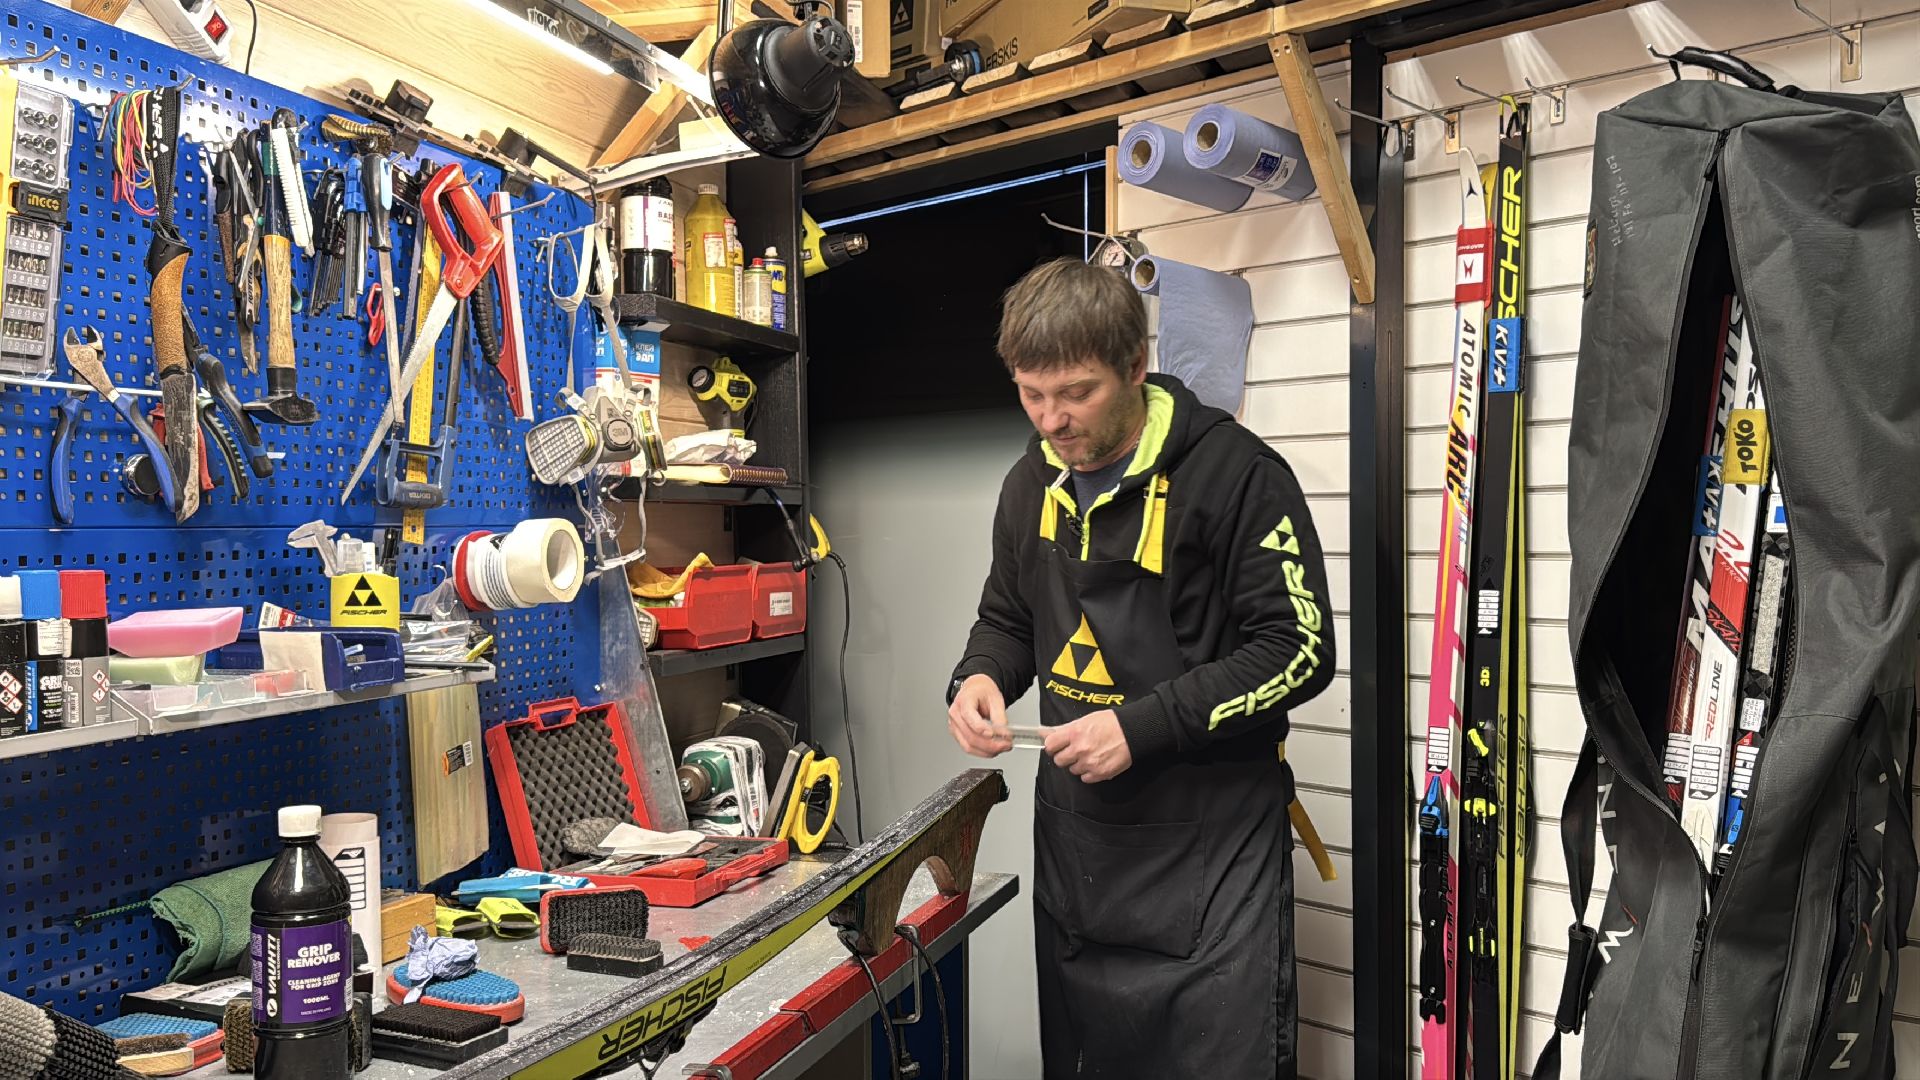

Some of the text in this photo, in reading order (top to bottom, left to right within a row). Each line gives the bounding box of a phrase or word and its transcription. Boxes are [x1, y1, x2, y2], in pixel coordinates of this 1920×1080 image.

[1497, 166, 1522, 320] SCHER
[1458, 318, 1477, 418] ATOMIC
[612, 427, 628, 437] 3M
[1734, 418, 1758, 474] TOKO
[1208, 560, 1322, 731] FISCHER
[1045, 679, 1125, 706] FISCHER
[1703, 659, 1723, 742] REDLINE
[1497, 713, 1507, 860] FISCHER
[1515, 713, 1526, 859] FISCHER
[267, 933, 277, 995] VAUHTI
[287, 951, 341, 969] REMOVER
[288, 972, 341, 986] CLEANING AGENT
[297, 943, 333, 958] GRIP
[306, 981, 322, 989] GRIP
[323, 978, 338, 987] ZONE
[598, 965, 728, 1061] FISCHER
